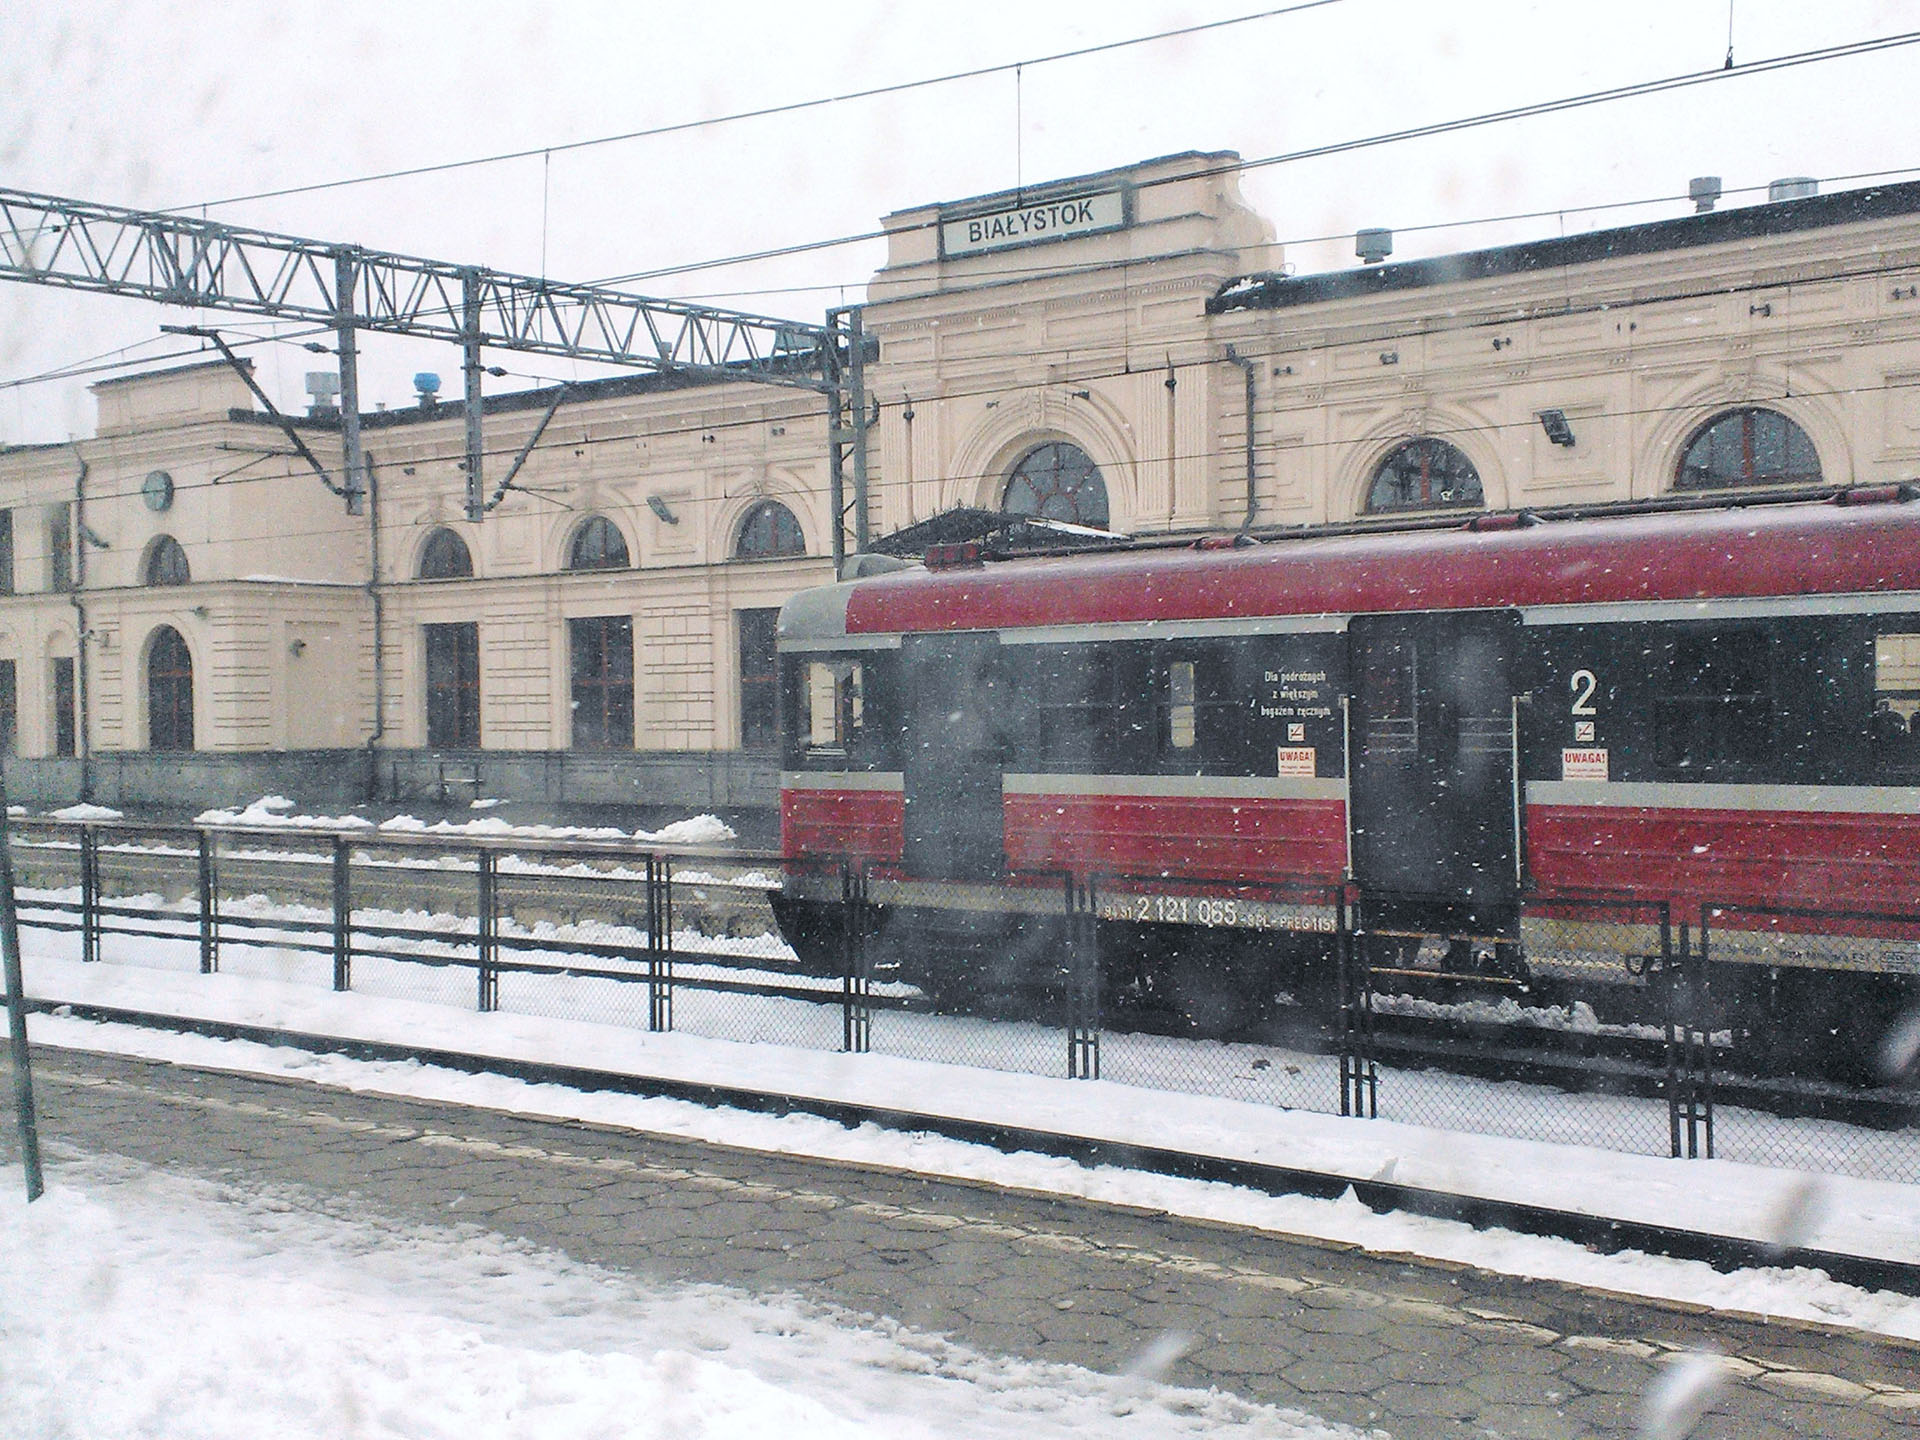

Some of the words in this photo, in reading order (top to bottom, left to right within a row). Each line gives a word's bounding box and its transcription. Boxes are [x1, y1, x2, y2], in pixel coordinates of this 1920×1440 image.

[968, 199, 1094, 243] BIAŁYSTOK
[1264, 671, 1278, 682] Dla
[1272, 690, 1278, 699] z
[1570, 669, 1597, 715] 2
[1280, 751, 1313, 761] UWAGA!
[1565, 752, 1605, 763] UWAGA!
[1137, 896, 1150, 919] 2
[1156, 897, 1188, 921] 121
